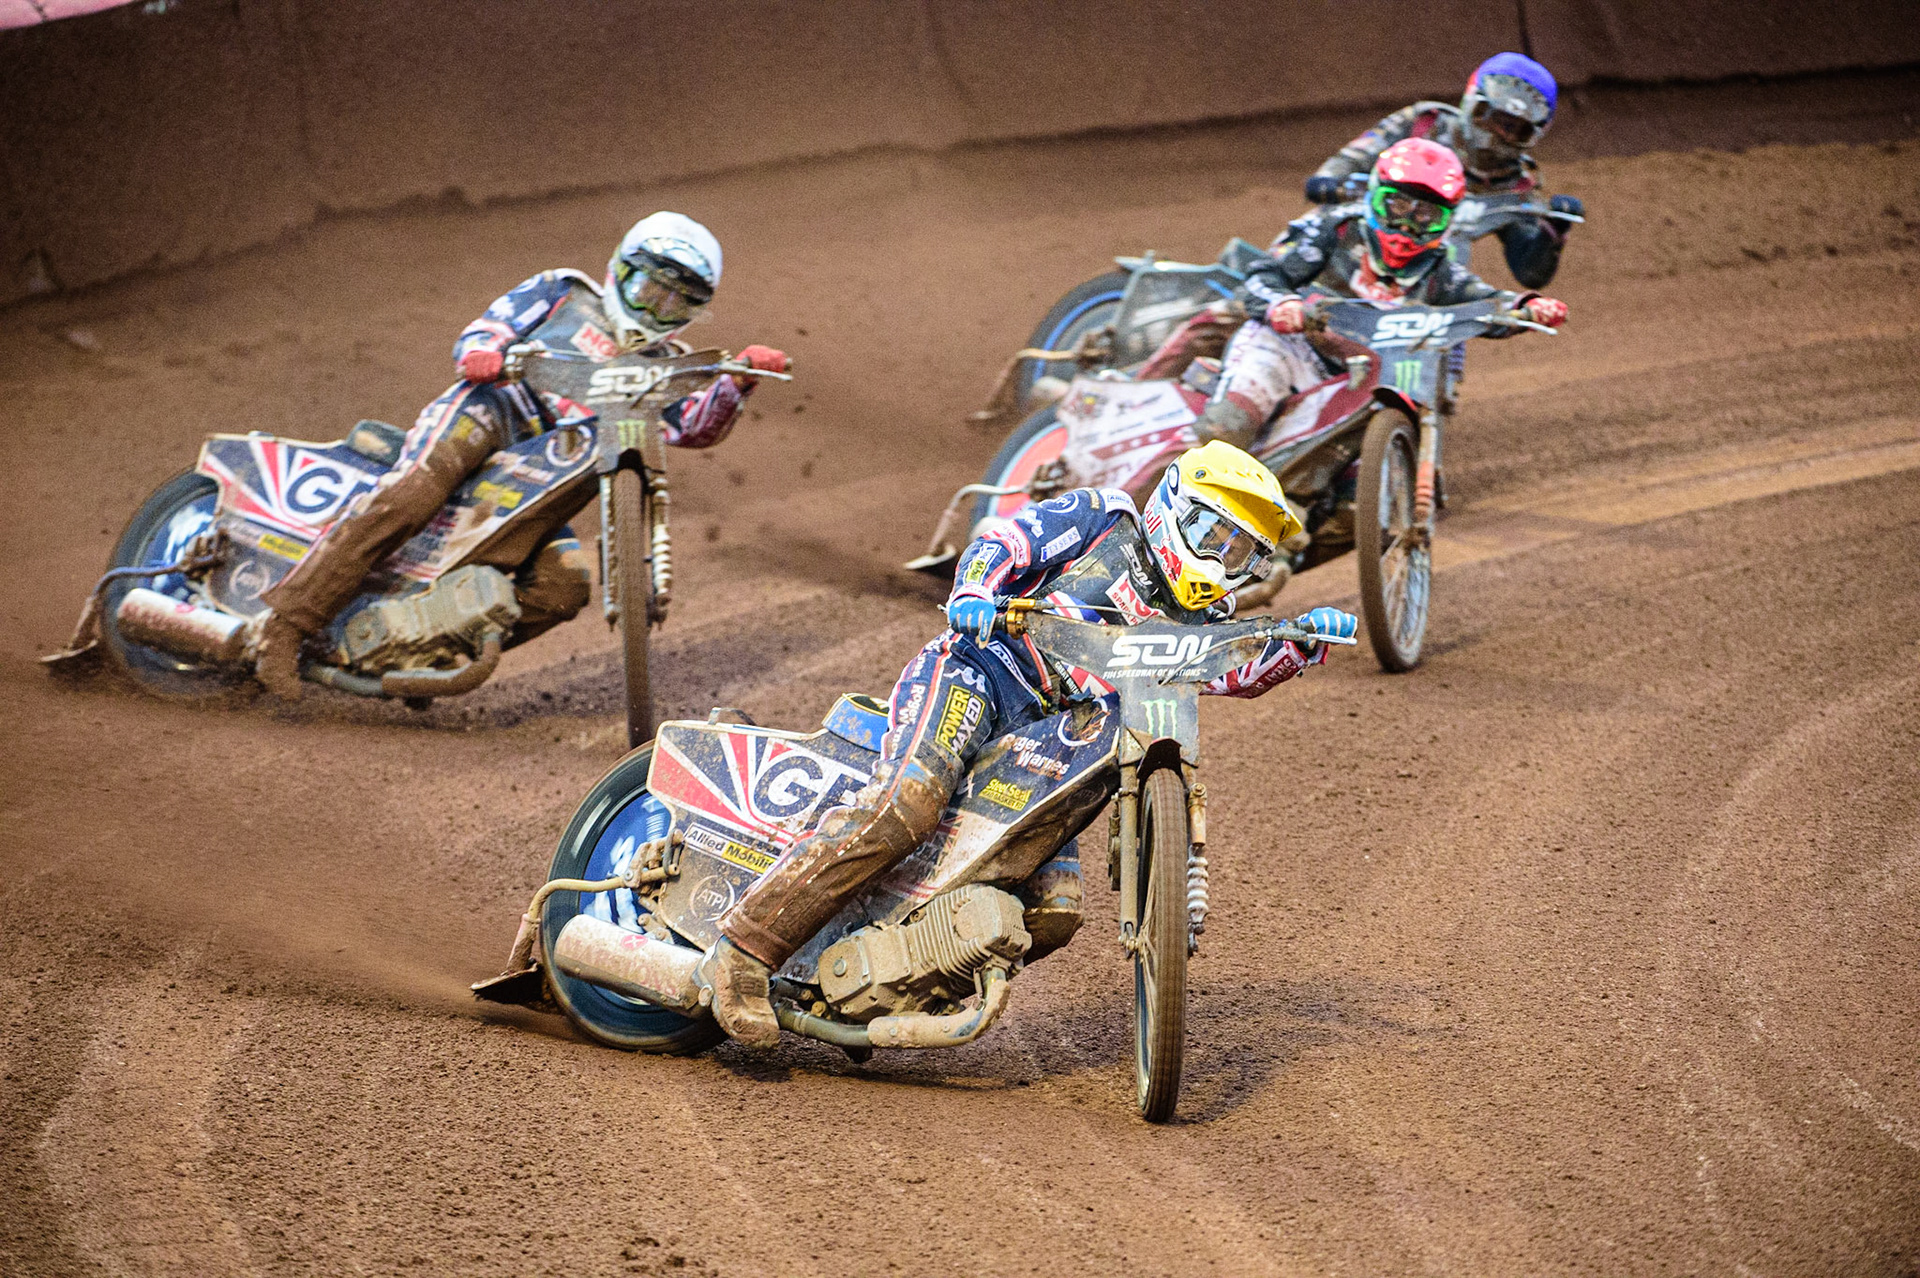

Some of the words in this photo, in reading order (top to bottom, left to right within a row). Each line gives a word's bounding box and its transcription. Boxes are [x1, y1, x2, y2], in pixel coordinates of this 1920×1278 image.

[1119, 578, 1159, 618] NG
[1066, 676, 1083, 695] BRITA
[1117, 668, 1157, 679] SPEEDWAY
[939, 690, 970, 748] POWER
[951, 696, 982, 753] MAXED
[1015, 749, 1071, 775] Warnes
[688, 829, 726, 853] Allied
[725, 844, 776, 870] Mobili
[696, 888, 728, 910] ATPI
